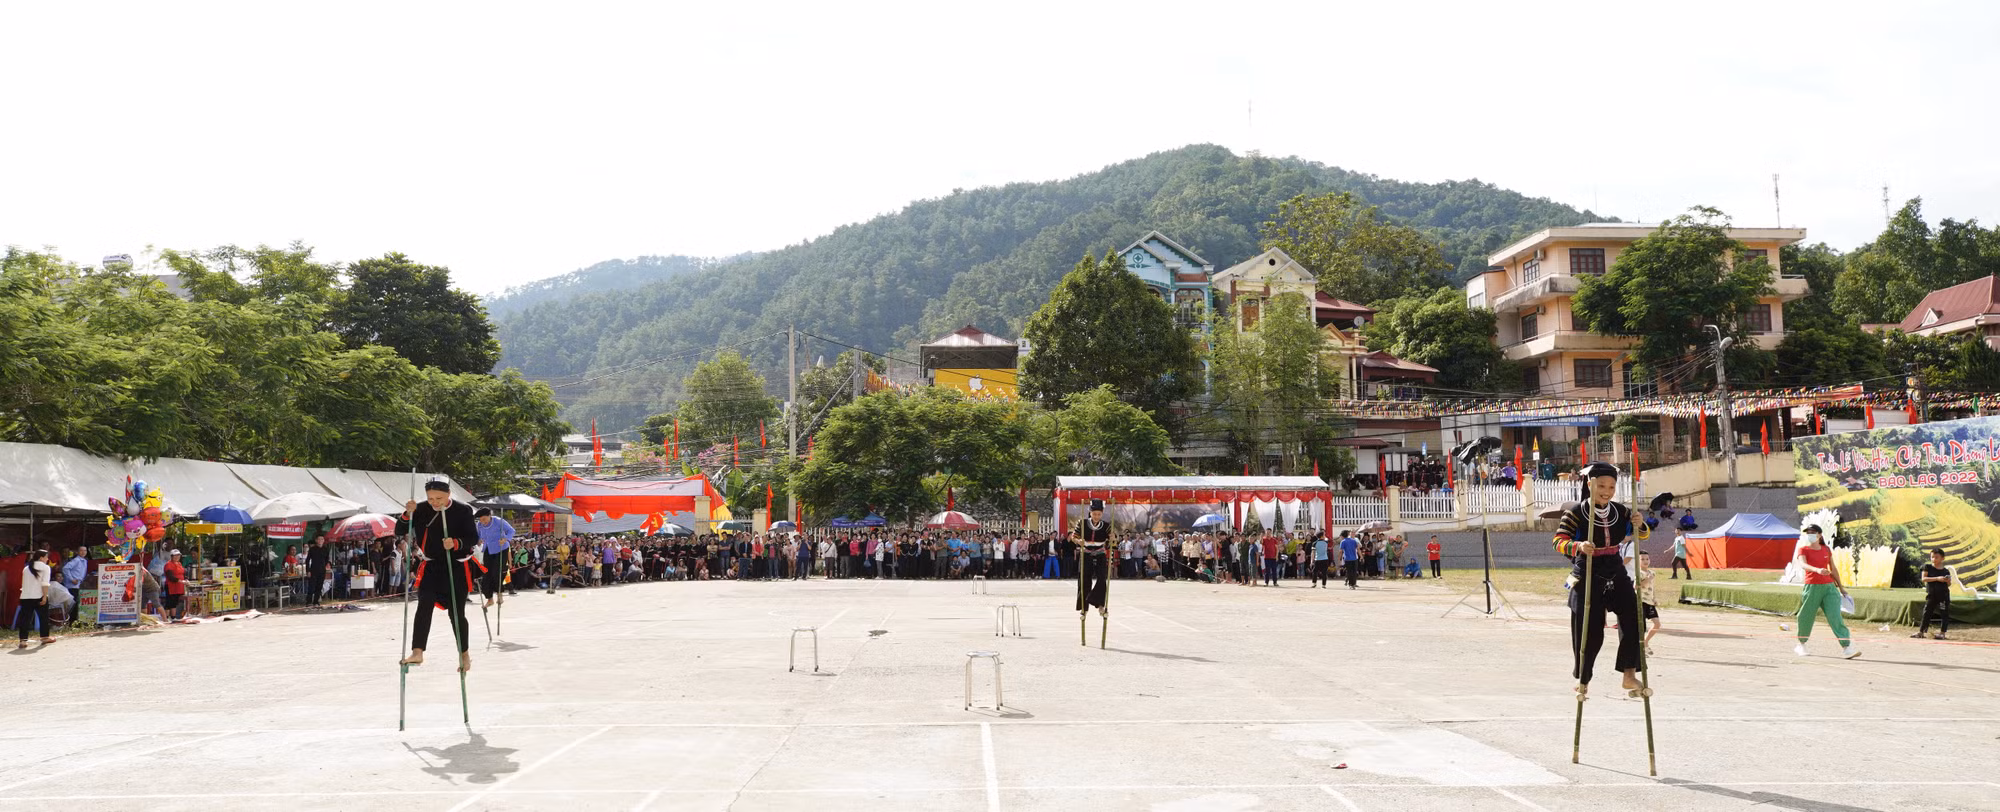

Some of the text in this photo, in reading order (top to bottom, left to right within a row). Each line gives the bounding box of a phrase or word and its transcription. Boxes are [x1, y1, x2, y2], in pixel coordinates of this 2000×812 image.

[1948, 439, 1990, 482] Phong
[1909, 473, 1938, 488] LẠC
[1940, 471, 1978, 485] 2022
